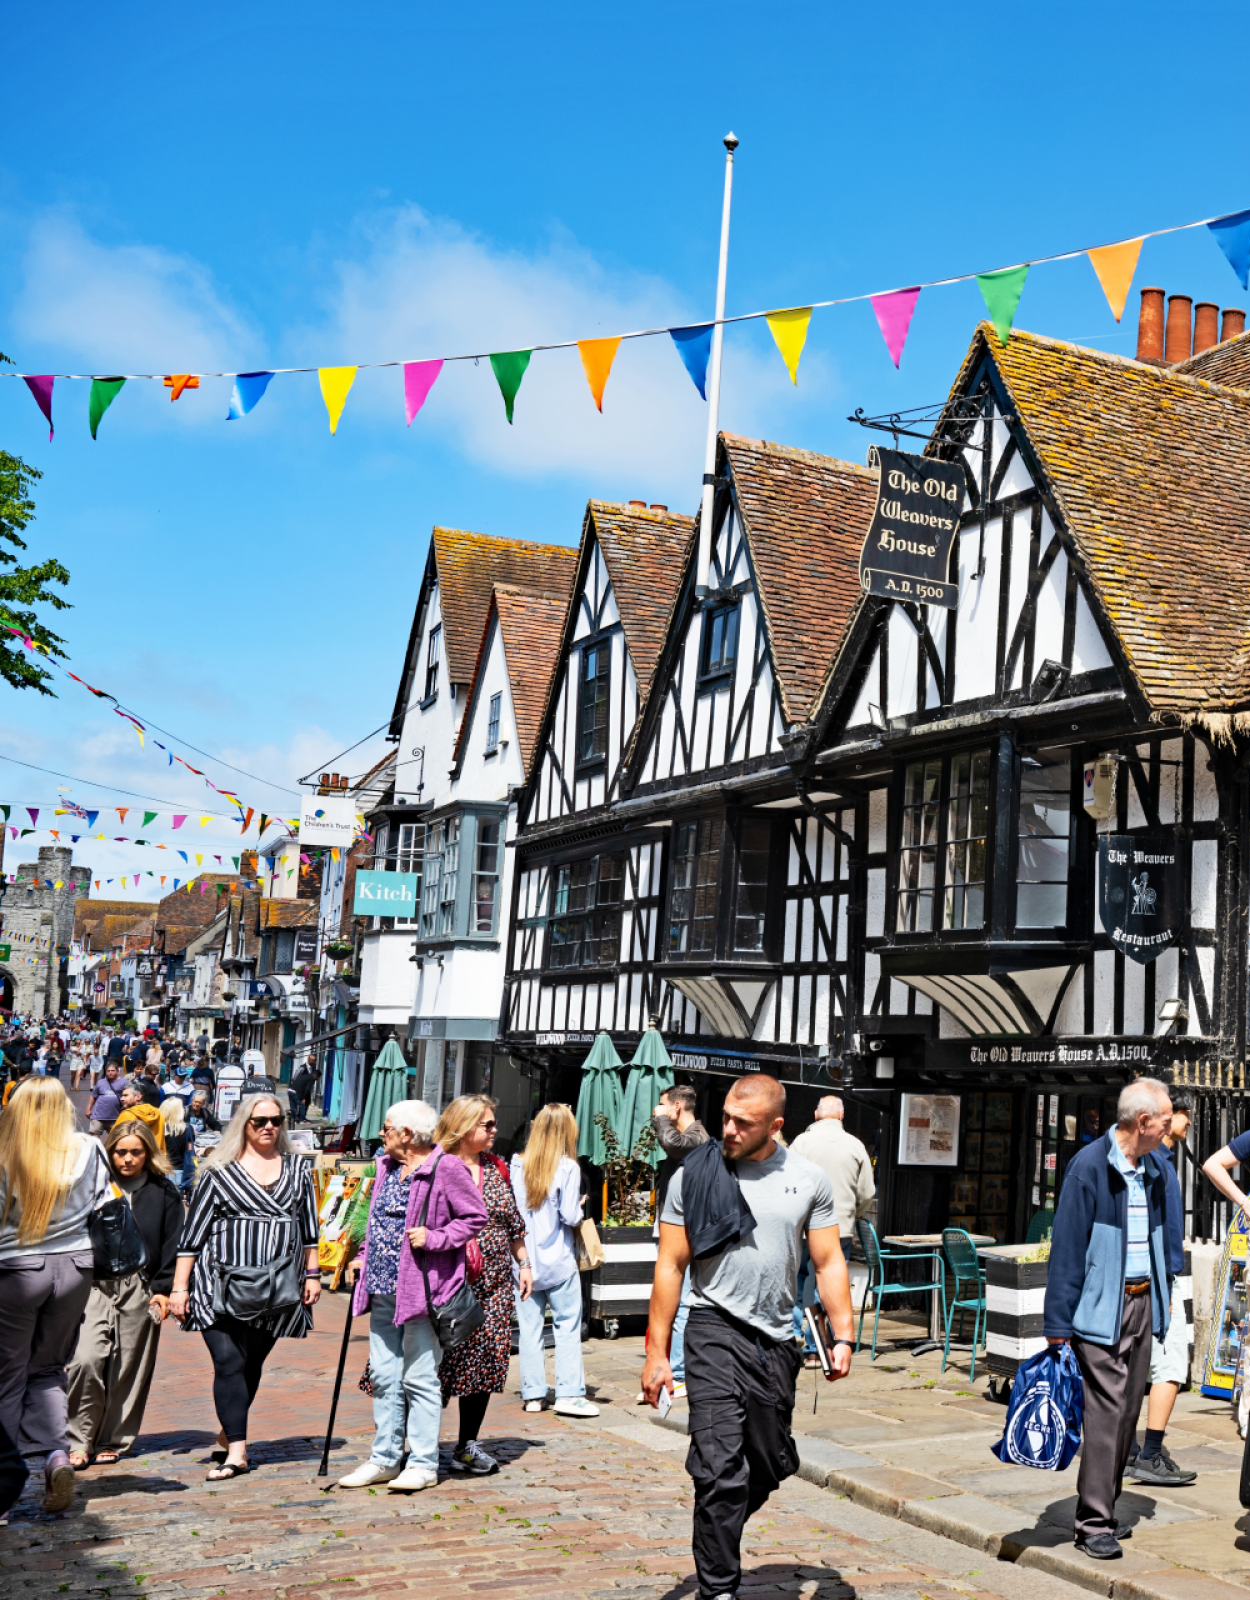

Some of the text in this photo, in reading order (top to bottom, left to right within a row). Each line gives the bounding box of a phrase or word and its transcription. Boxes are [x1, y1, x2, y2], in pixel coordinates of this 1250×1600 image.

[888, 470, 957, 501] The Old
[880, 499, 953, 530] Weavers
[877, 529, 936, 557] House
[916, 584, 944, 598] 1500
[304, 821, 334, 829] Children's
[1108, 850, 1175, 865] The Weavers
[358, 882, 413, 901] Kitch
[1112, 926, 1173, 945] Restaurant
[970, 1046, 988, 1065] The
[990, 1046, 1008, 1062] Old
[1011, 1046, 1055, 1063] Weavers
[1058, 1045, 1093, 1064] House
[727, 1059, 743, 1069] PASTA
[744, 1060, 760, 1071] GRILL
